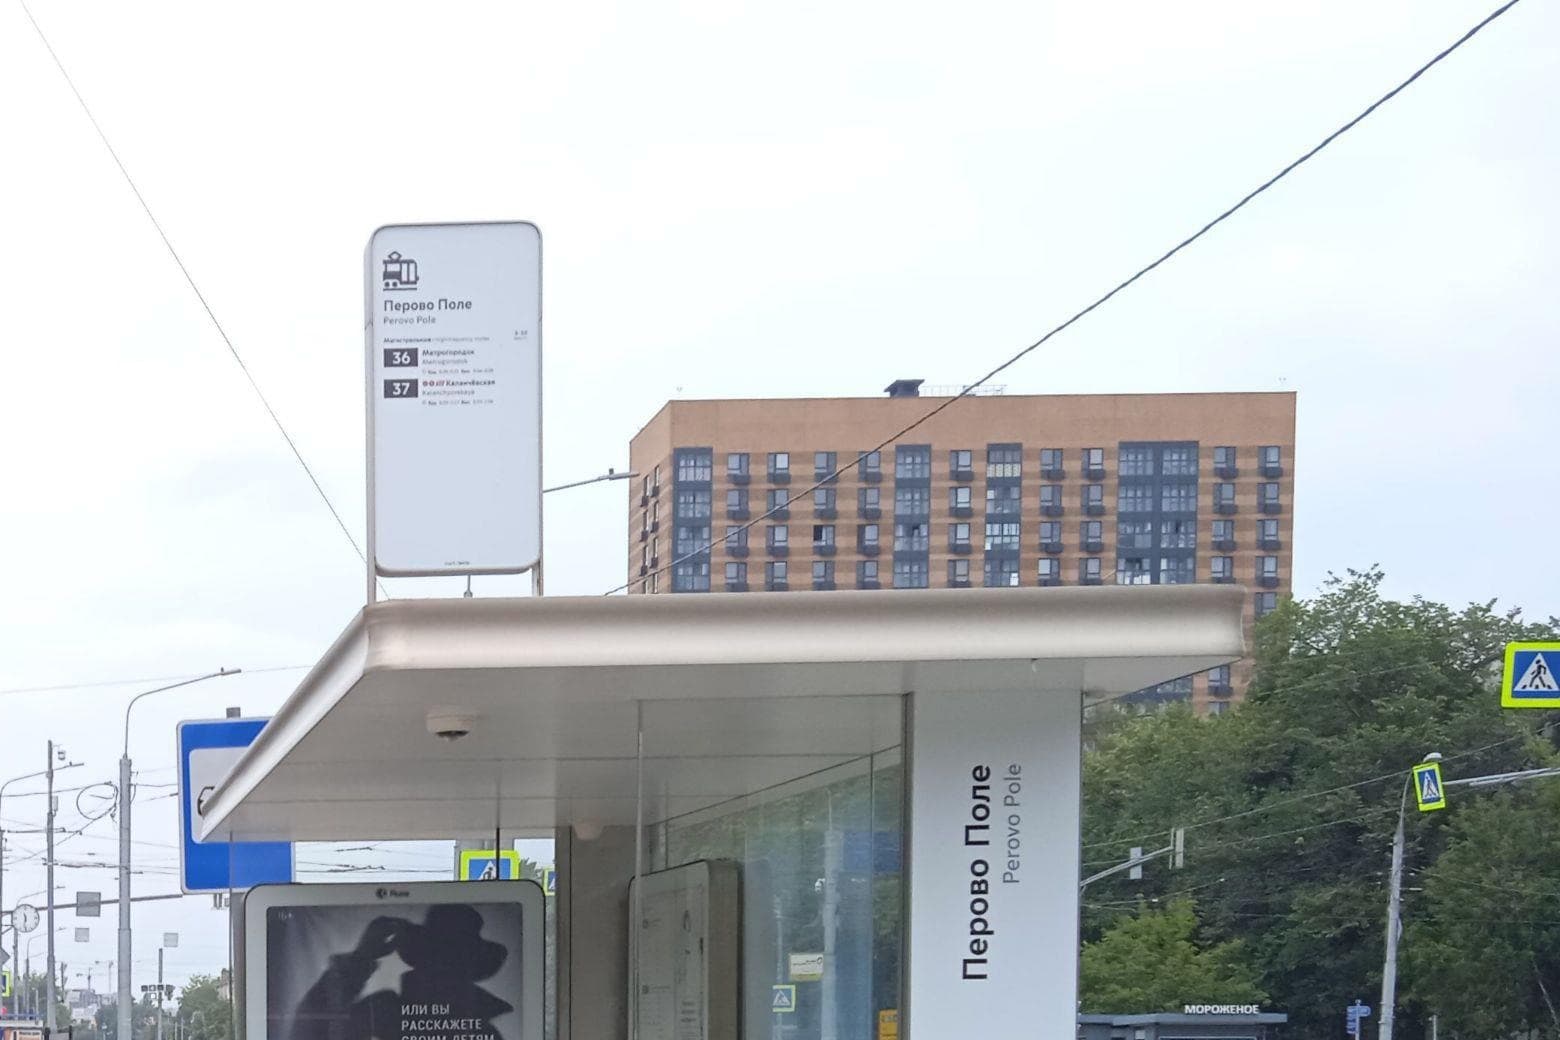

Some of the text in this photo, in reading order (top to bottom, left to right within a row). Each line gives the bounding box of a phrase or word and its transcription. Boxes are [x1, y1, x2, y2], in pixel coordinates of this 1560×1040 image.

[384, 298, 473, 314] Перово Поле
[383, 315, 436, 325] Perovo Pole
[392, 352, 411, 365] 36
[392, 382, 410, 396] 37
[1003, 763, 1022, 884] Perovo Pole
[962, 764, 994, 980] Перово Поле
[401, 1004, 450, 1015] ИЛИ ВЫ
[1185, 1004, 1259, 1014] МОРОЖЕНОЕ
[401, 1018, 482, 1031] РАССКАЖЕТЕ
